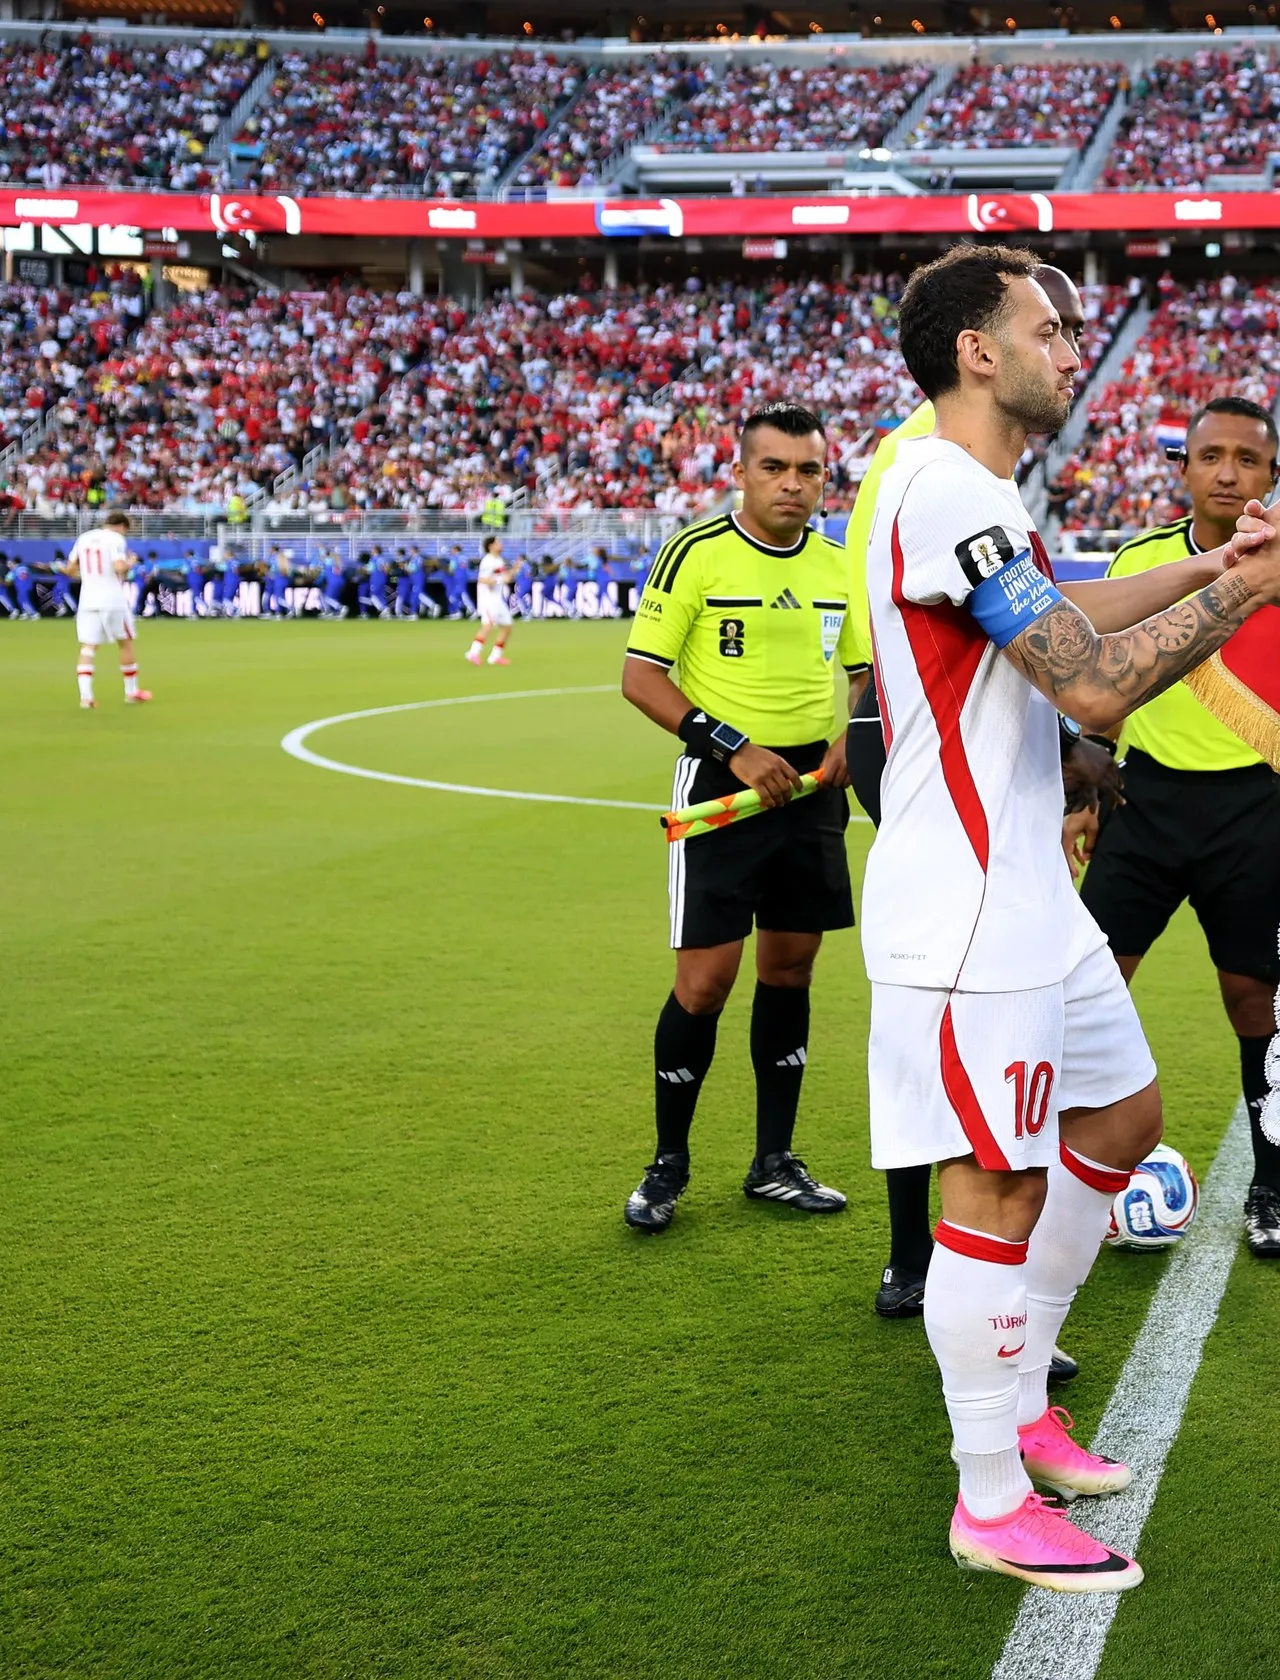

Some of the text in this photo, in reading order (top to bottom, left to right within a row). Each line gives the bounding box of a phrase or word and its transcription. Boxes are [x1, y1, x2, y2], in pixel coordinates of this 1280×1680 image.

[85, 548, 103, 576] 11
[1003, 566, 1042, 601] UNITE
[640, 598, 662, 614] FIFA
[1009, 598, 1030, 616] the
[1032, 595, 1052, 613] FIFA
[1004, 1060, 1055, 1141] 10
